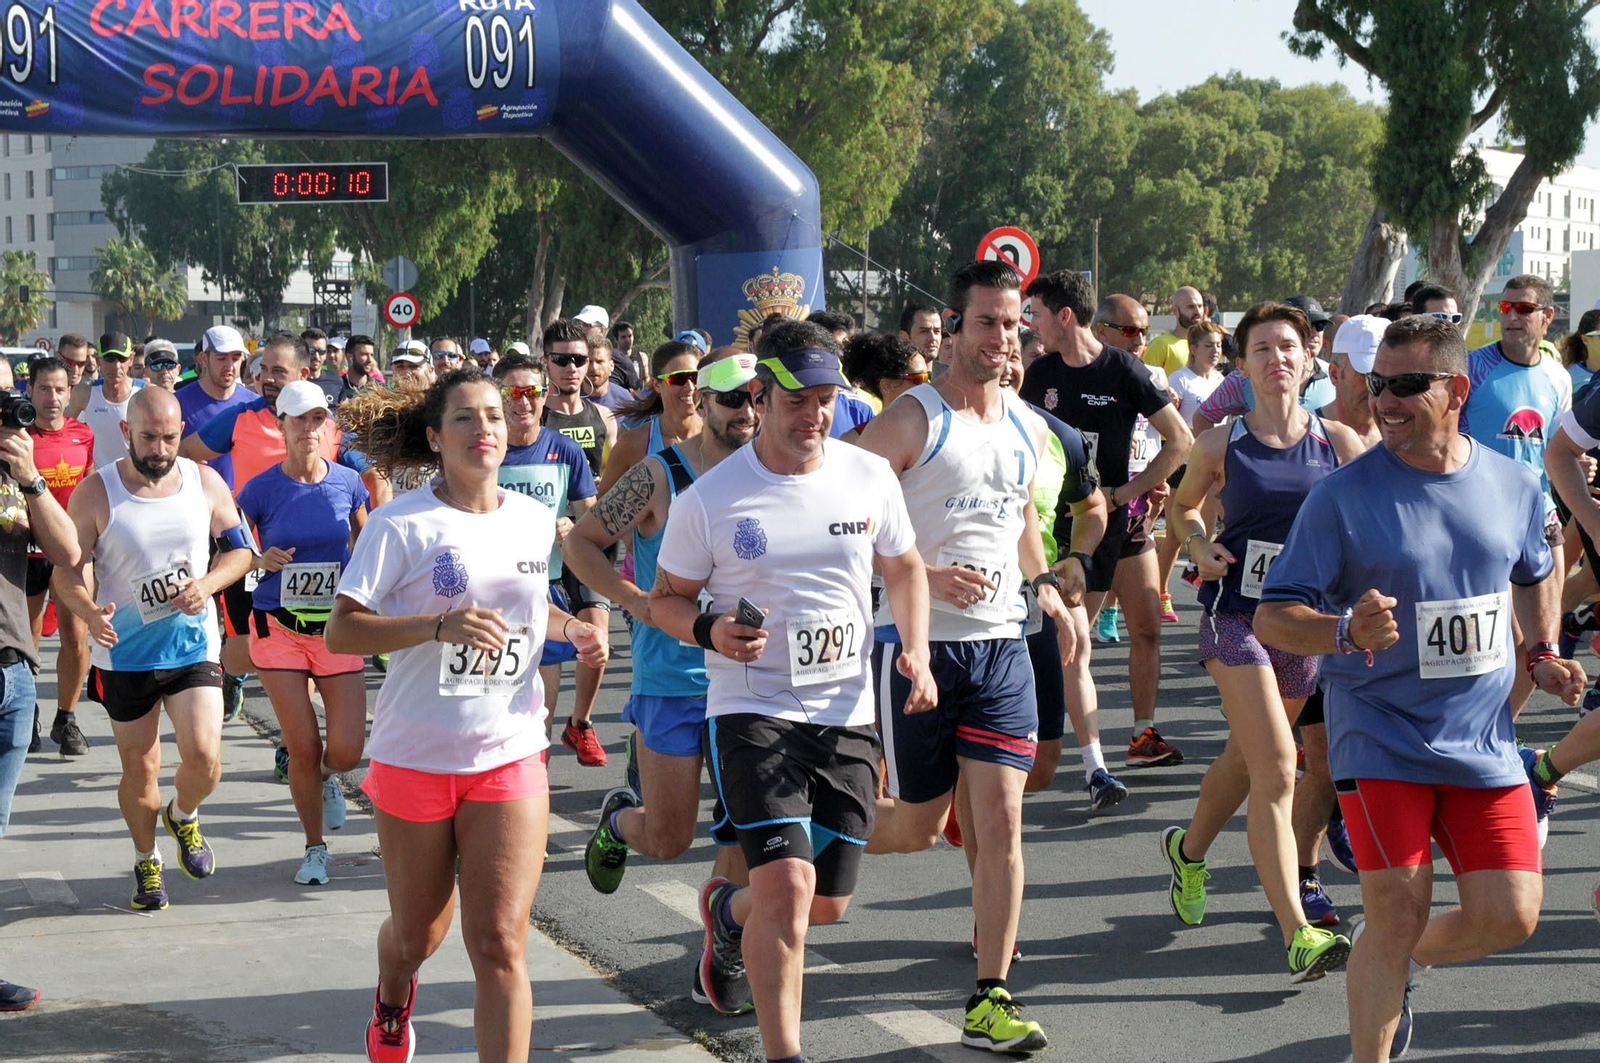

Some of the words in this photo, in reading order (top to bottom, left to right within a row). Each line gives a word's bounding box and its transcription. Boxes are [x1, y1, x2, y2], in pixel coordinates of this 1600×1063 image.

[89, 0, 362, 42] CARRERA
[0, 4, 56, 83] 91
[466, 14, 534, 89] 091
[141, 62, 439, 108] SOLIDARIA
[391, 303, 413, 317] 40
[1081, 393, 1116, 402] POLICIA
[561, 427, 593, 441] FILA
[828, 521, 867, 536] CNP
[286, 571, 336, 596] 4224
[516, 561, 547, 574] CNP
[797, 622, 855, 667] 3292
[1427, 610, 1498, 657] 4017
[449, 638, 521, 676] 3295
